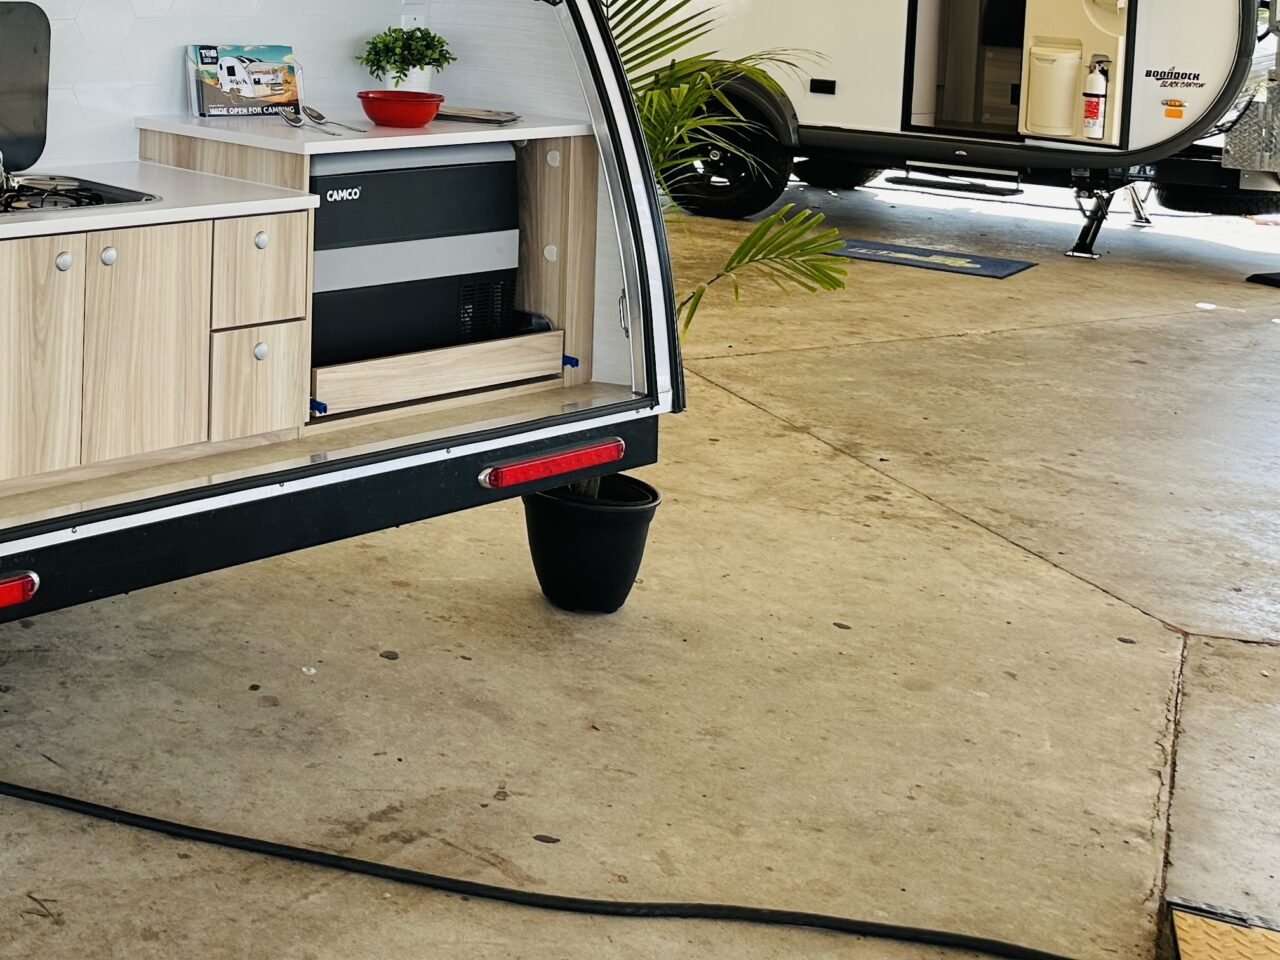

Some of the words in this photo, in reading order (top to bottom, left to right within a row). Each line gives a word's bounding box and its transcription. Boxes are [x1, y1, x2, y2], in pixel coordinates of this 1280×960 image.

[1145, 70, 1200, 81] BOONDOCK
[209, 107, 229, 115] WIDE
[249, 106, 263, 114] FOR
[326, 188, 360, 201] CAMCO
